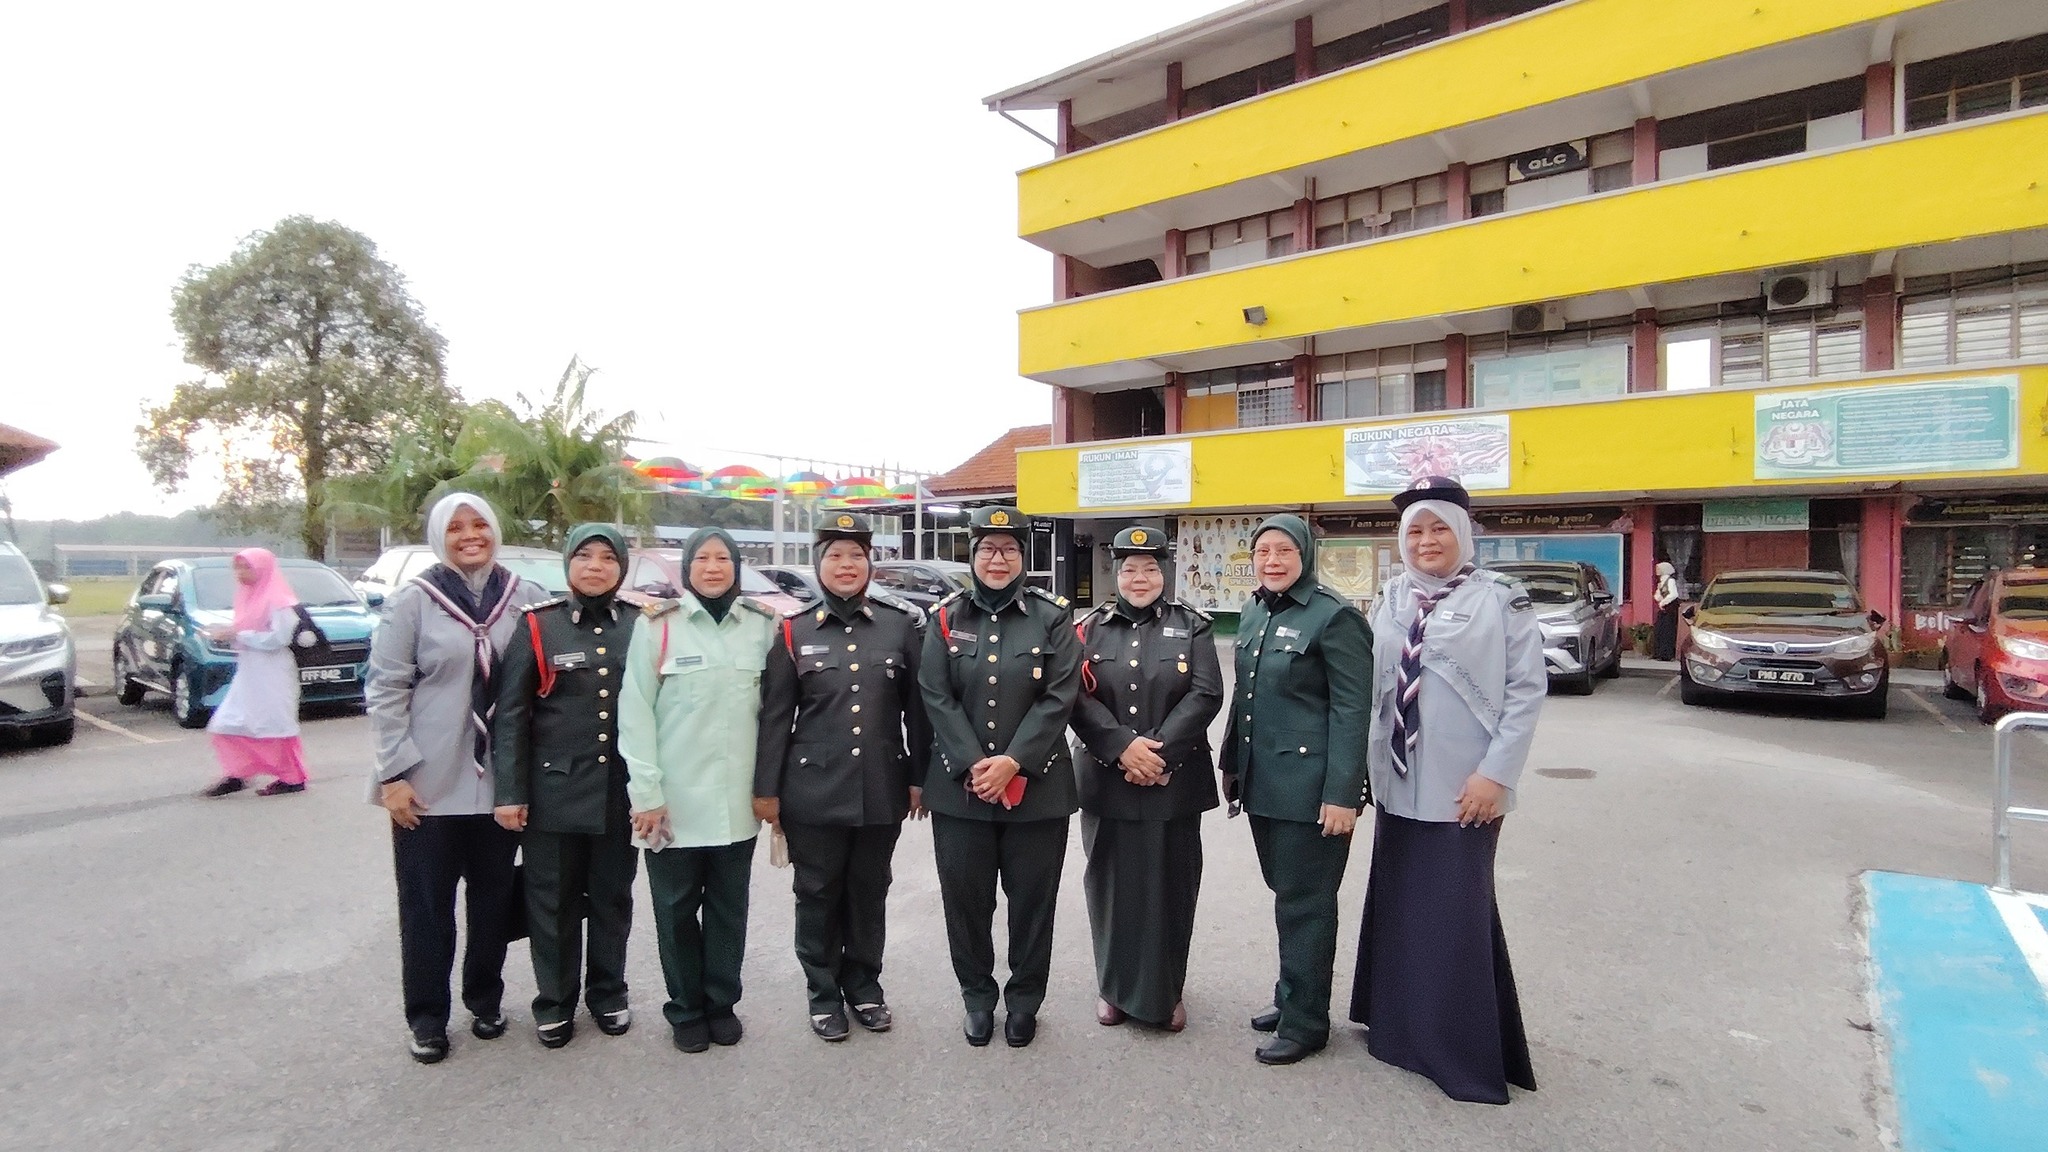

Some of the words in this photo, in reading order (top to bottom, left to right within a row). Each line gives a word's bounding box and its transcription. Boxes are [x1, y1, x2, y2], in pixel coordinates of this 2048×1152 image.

[1782, 400, 1809, 409] JATA
[1772, 410, 1820, 420] NEGARA
[1351, 429, 1393, 443] RUKUN
[1398, 425, 1450, 439] NEGARA
[1083, 453, 1112, 463] RUKUN
[1115, 451, 1138, 460] IMAN
[1225, 564, 1233, 577] A
[1234, 563, 1256, 577] STA
